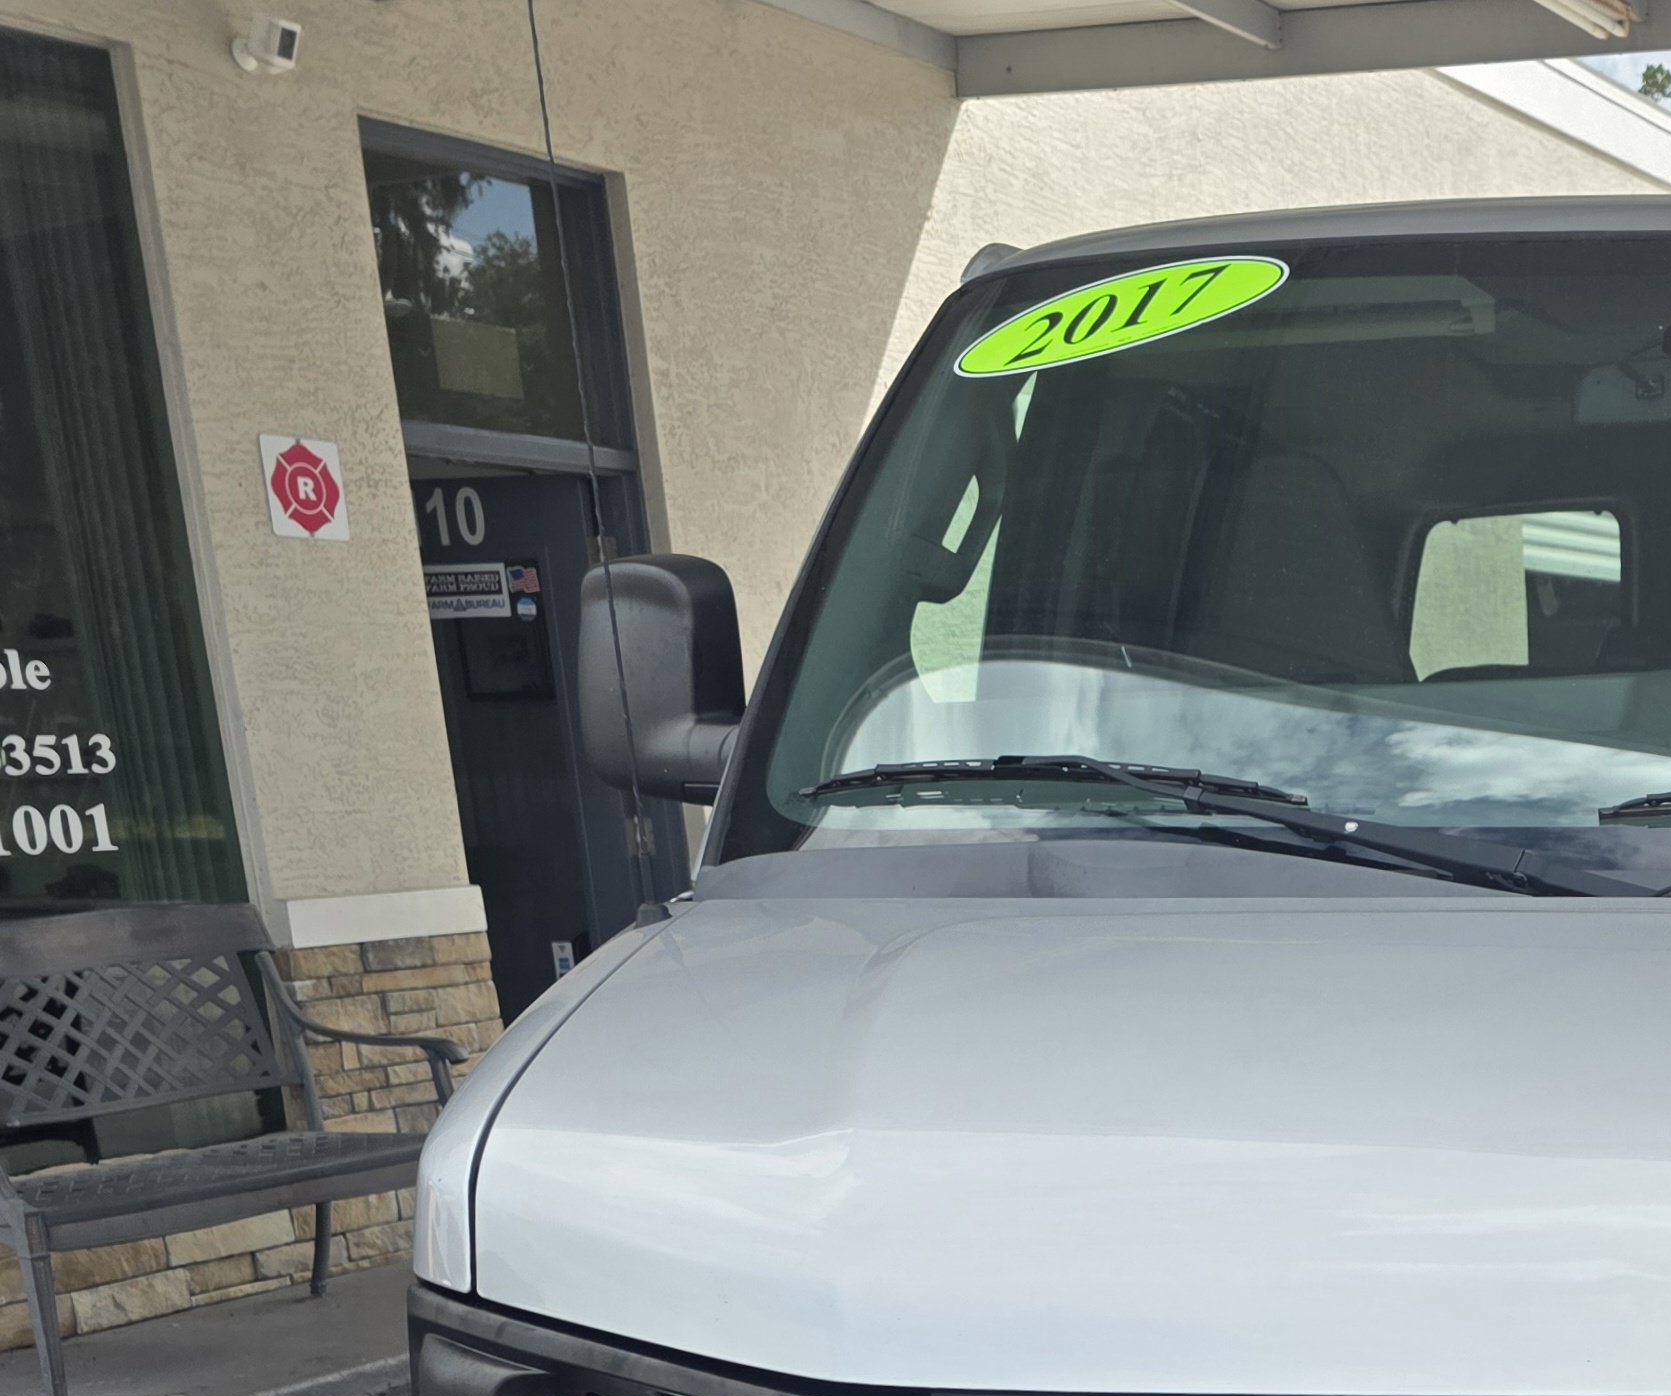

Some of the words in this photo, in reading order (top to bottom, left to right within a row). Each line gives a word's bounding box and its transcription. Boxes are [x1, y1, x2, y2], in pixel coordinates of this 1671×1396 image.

[1003, 263, 1232, 367] 2017
[296, 475, 318, 502] R
[412, 486, 486, 546] 10
[430, 599, 454, 609] ARM
[460, 582, 500, 592] PROUD
[0, 649, 51, 690] le
